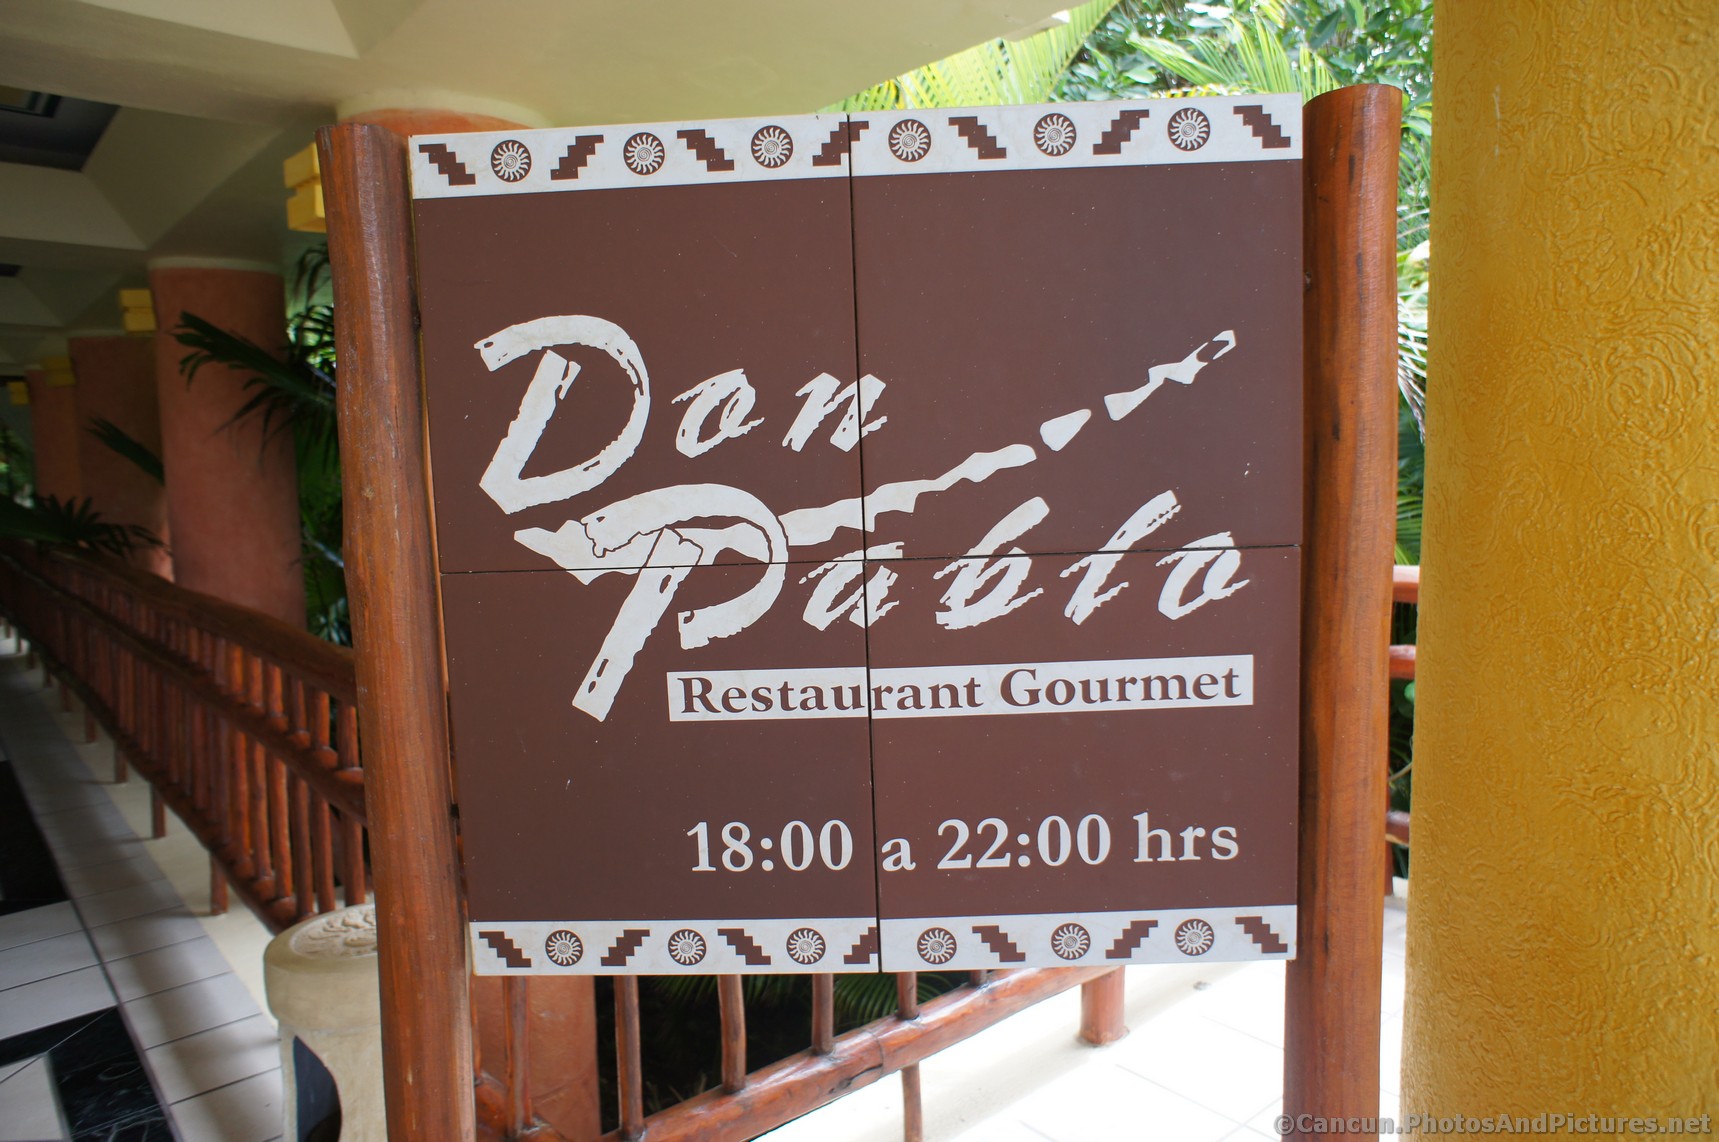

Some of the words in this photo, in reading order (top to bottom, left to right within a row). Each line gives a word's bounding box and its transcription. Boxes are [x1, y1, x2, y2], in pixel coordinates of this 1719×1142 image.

[473, 314, 888, 514] Don
[571, 483, 1250, 722] Pablo
[677, 673, 985, 714] Restaurant
[1000, 664, 1242, 708] Gourmet
[686, 819, 853, 873] 18:00
[881, 836, 917, 872] a
[937, 814, 1111, 869] 22:00
[1133, 812, 1240, 864] hrs
